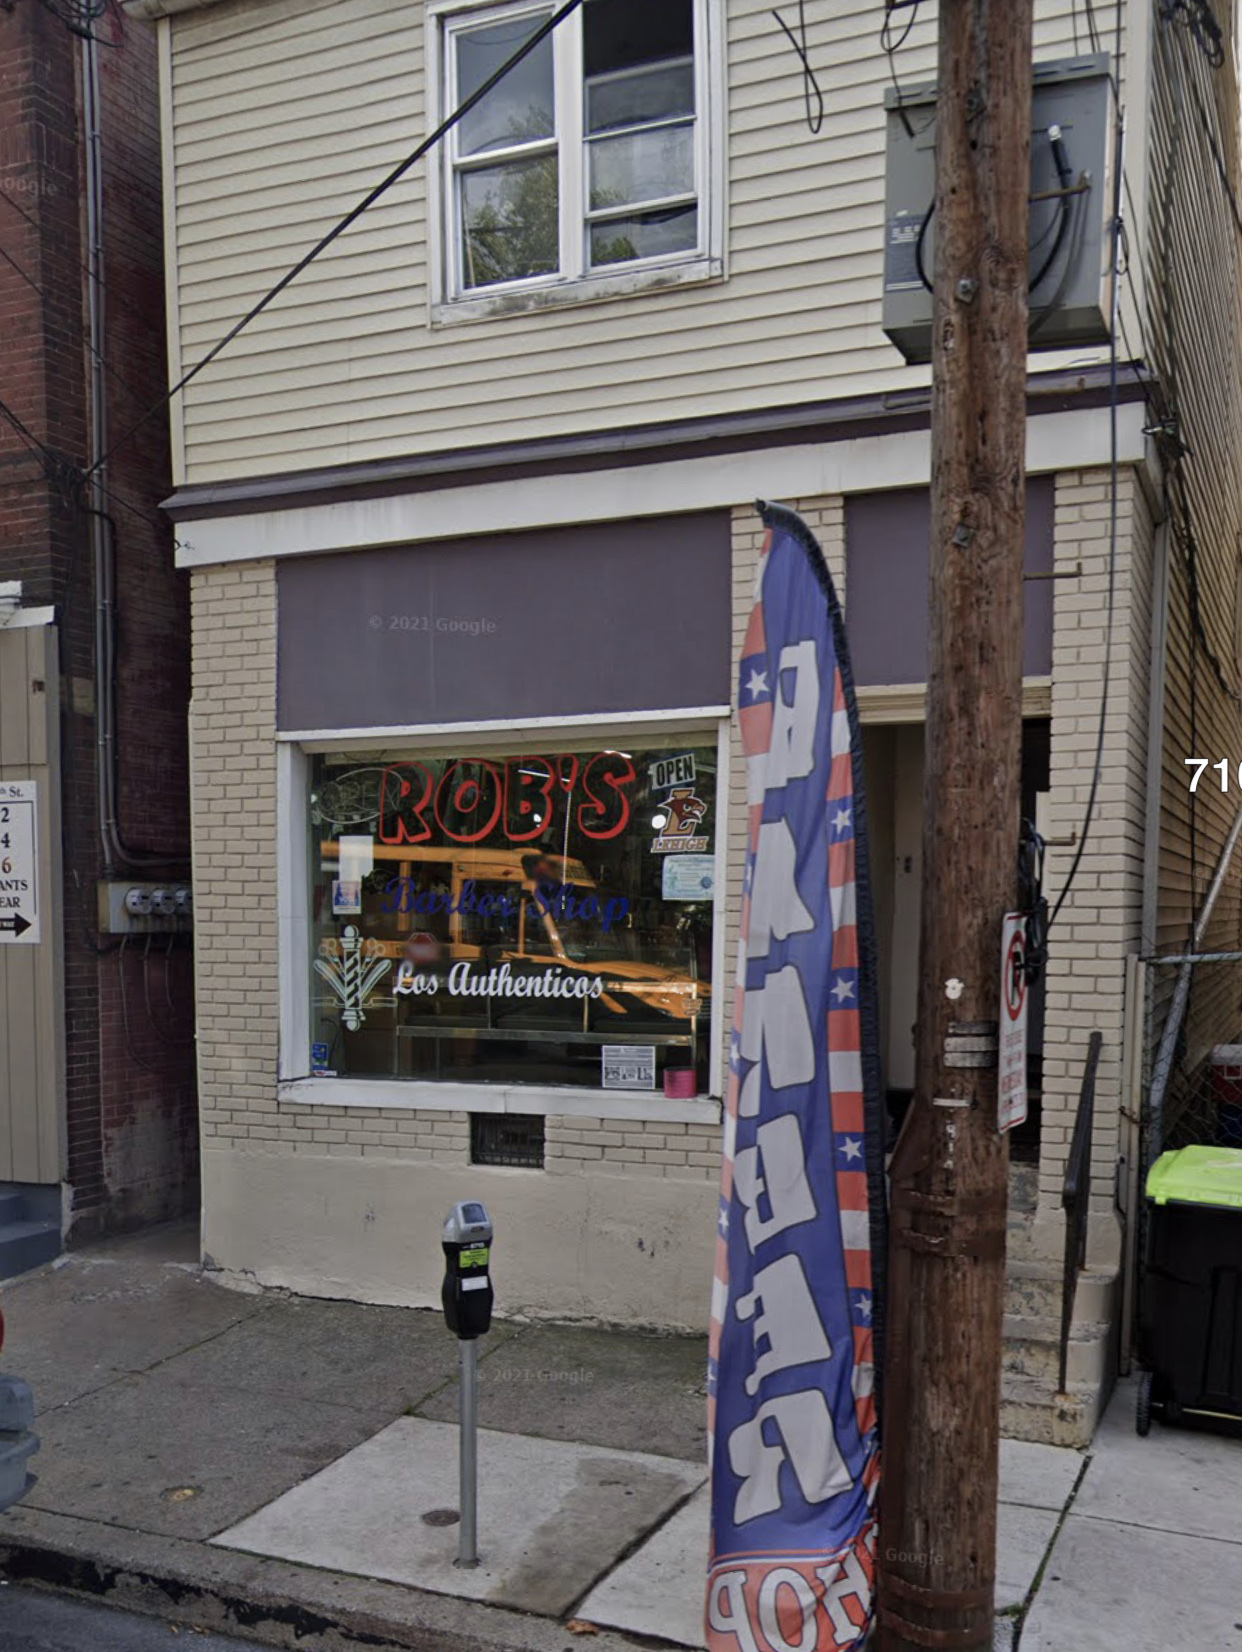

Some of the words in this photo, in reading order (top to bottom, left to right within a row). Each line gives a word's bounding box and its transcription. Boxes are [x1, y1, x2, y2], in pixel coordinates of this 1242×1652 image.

[656, 755, 694, 787] OPEN
[9, 785, 24, 798] St.
[378, 752, 637, 845] ROB'S
[652, 837, 709, 852] LEHIGH
[381, 876, 511, 917] Barber
[526, 882, 632, 933] Shop
[392, 960, 439, 996] Los
[447, 961, 604, 999] Authenticos
